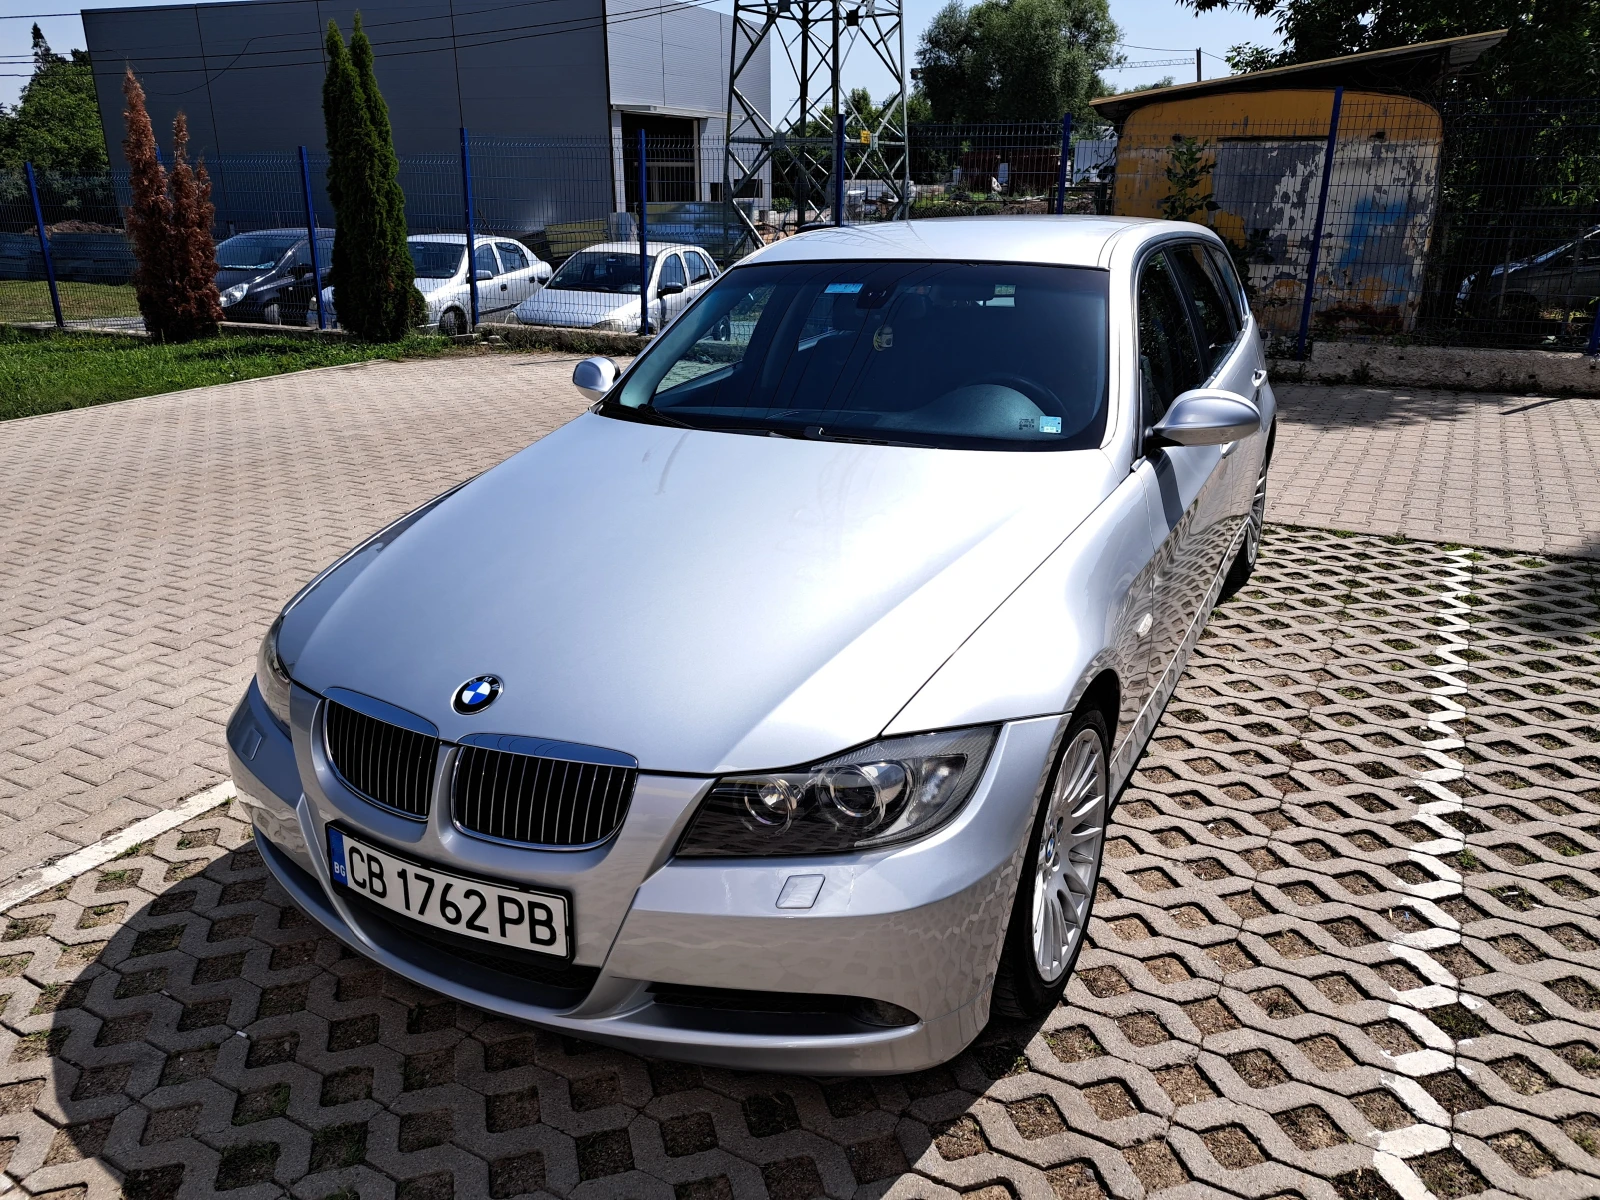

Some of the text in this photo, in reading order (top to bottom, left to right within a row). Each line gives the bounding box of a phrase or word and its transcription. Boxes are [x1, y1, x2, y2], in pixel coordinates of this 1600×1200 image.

[468, 676, 500, 690] BMW
[333, 861, 346, 877] BG
[348, 845, 557, 946] CB 1762 PB
